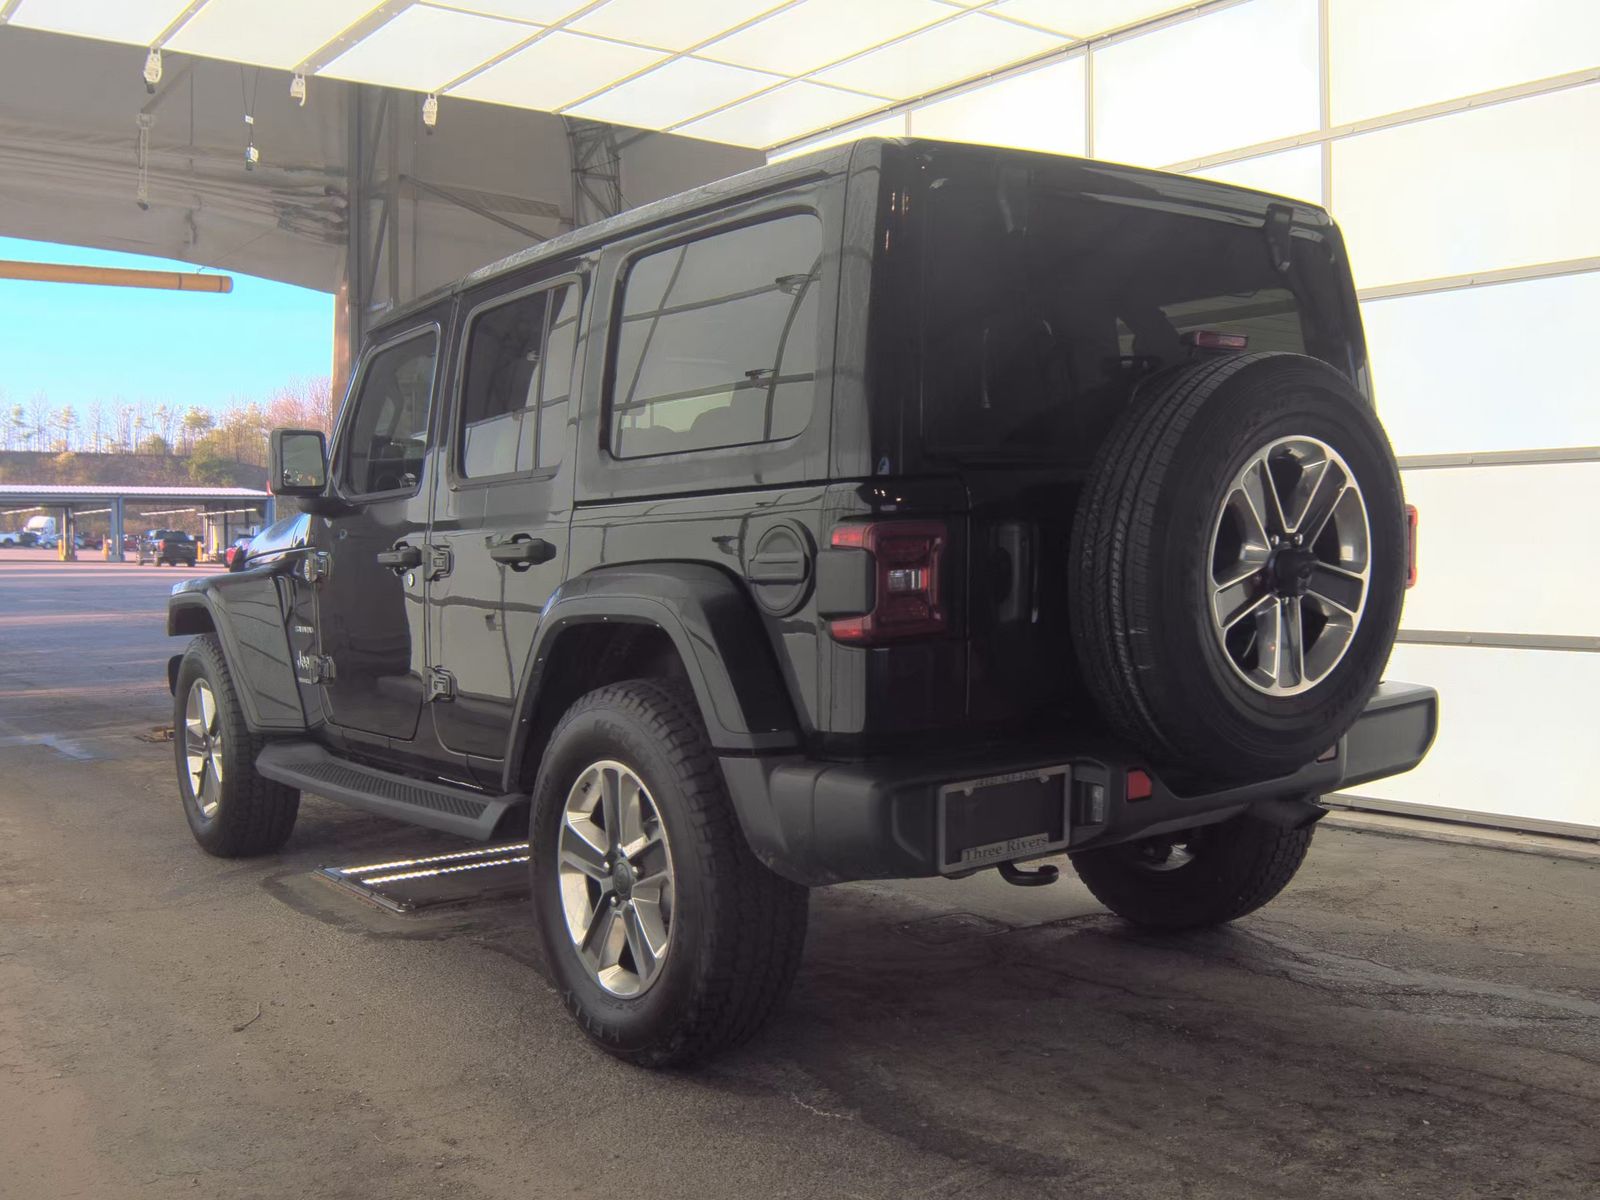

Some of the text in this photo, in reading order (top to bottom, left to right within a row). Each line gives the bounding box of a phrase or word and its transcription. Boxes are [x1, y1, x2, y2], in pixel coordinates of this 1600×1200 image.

[297, 650, 310, 671] Jee
[965, 837, 1048, 861] Three Rivers
